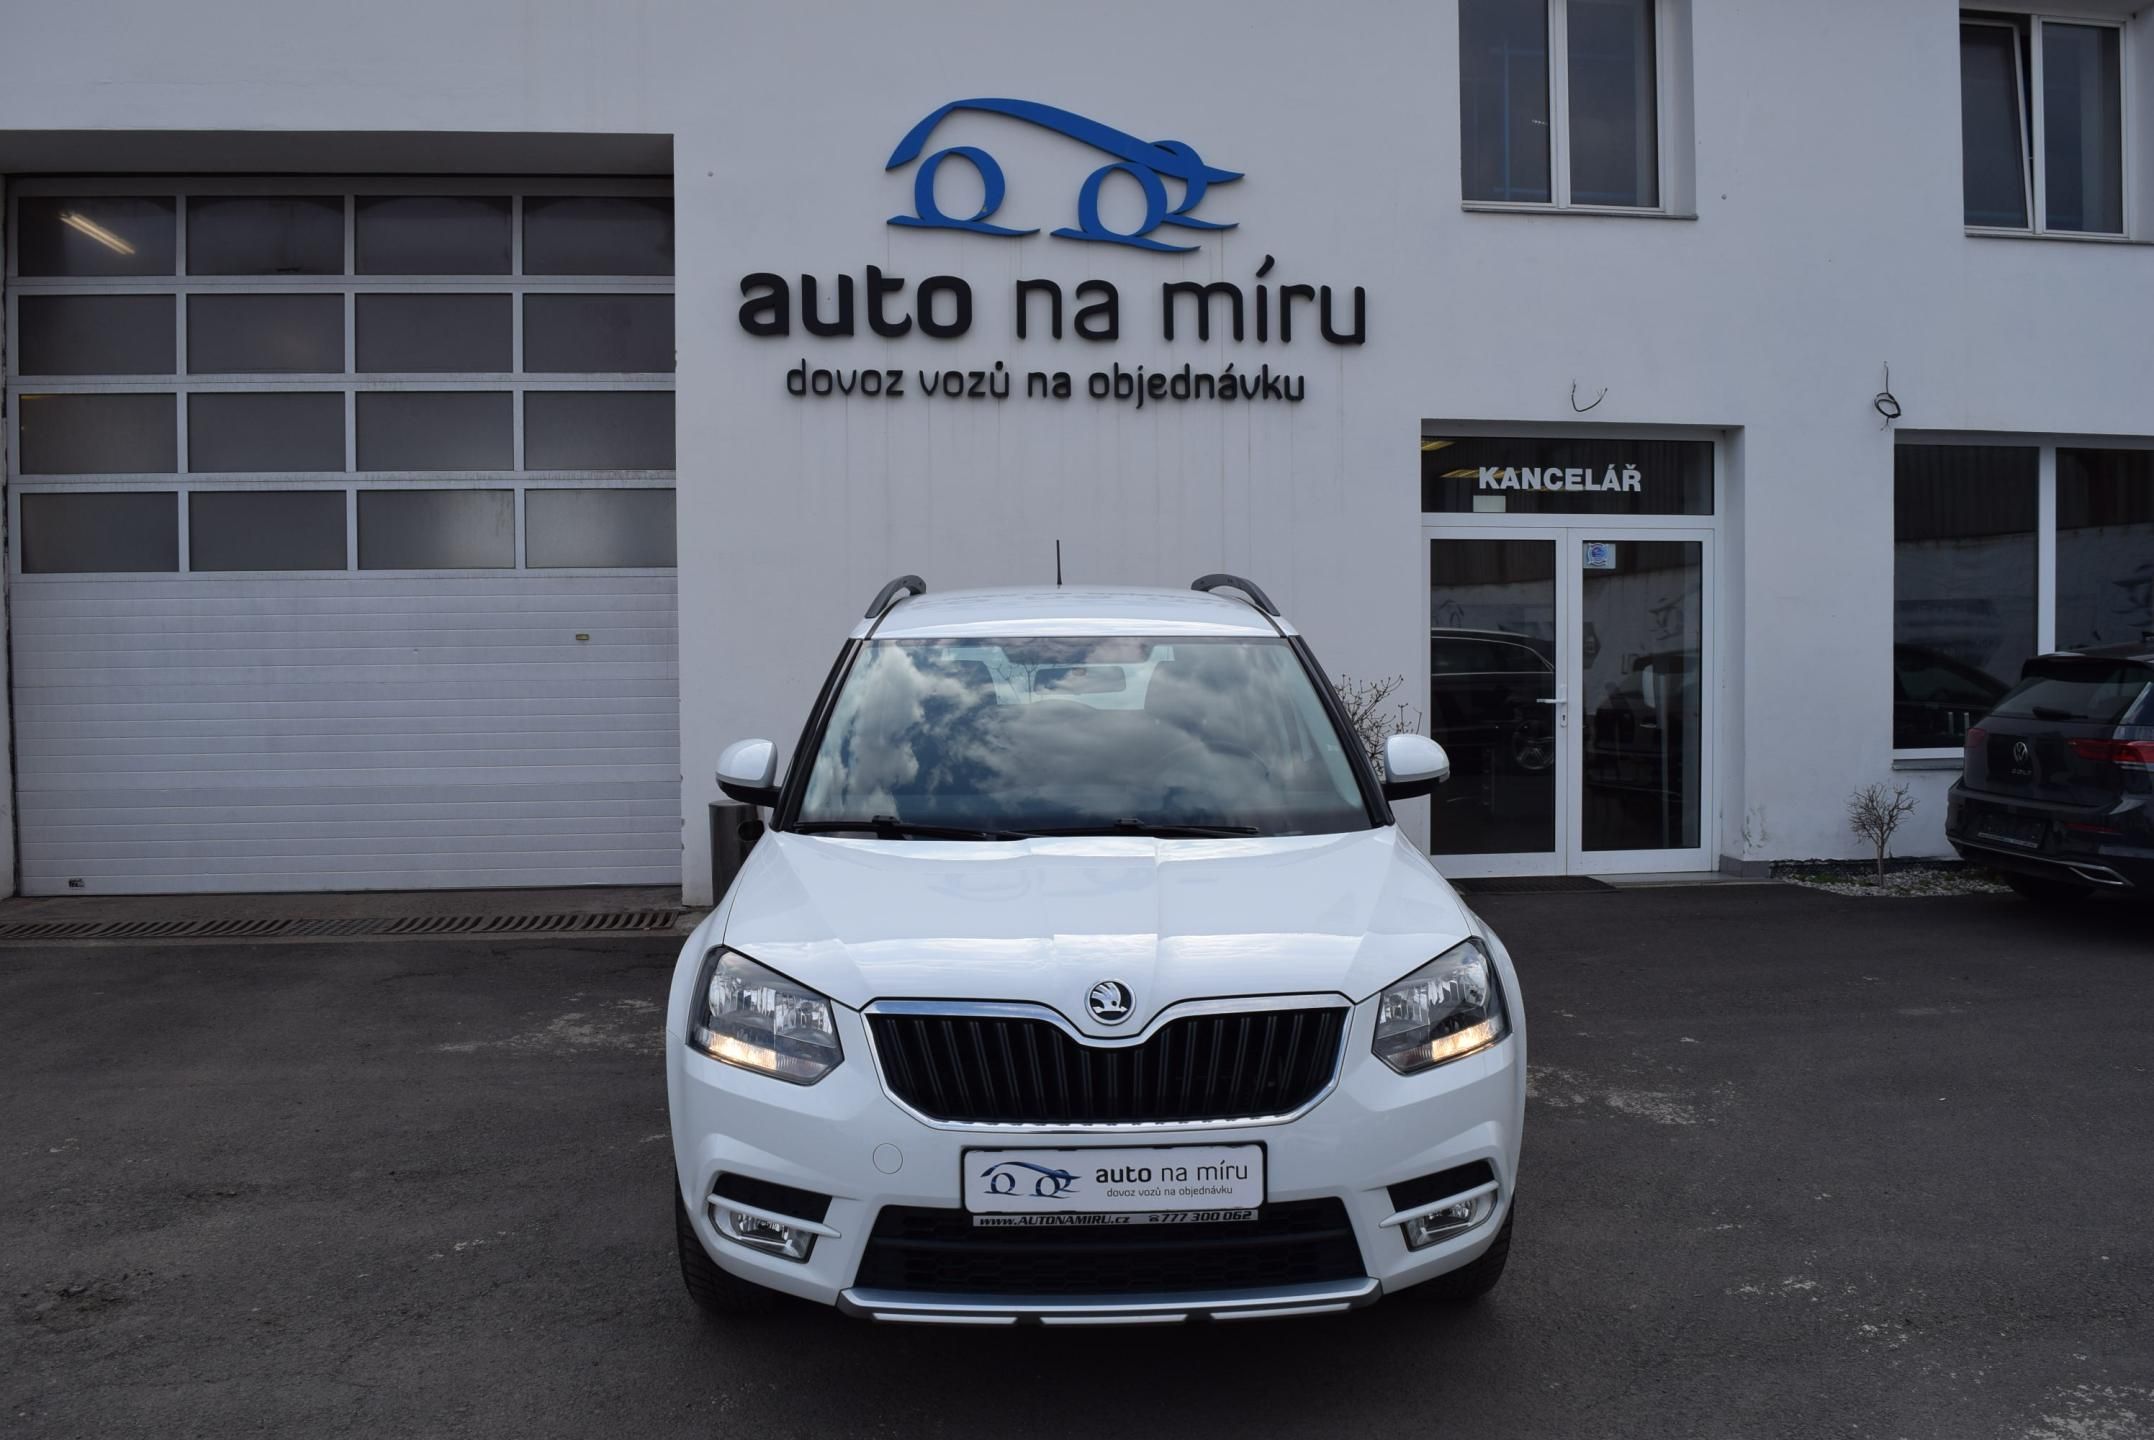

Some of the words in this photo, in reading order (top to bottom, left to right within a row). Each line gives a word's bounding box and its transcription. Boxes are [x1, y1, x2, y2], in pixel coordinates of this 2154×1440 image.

[738, 264, 973, 339] auto
[1015, 278, 1119, 341] na
[1162, 254, 1366, 345] míru
[786, 358, 904, 398] dovoz
[919, 360, 1011, 399] vozů
[1027, 370, 1072, 398] na
[1088, 363, 1304, 408] objednávku
[1478, 463, 1642, 492] KANCELÁŘ
[1095, 1166, 1151, 1184] auto
[1161, 1166, 1187, 1182] na
[1197, 1159, 1248, 1181] míru
[1106, 1187, 1136, 1198] dovoz
[1138, 1186, 1161, 1197] vozů
[1164, 1188, 1176, 1196] na
[1178, 1185, 1233, 1198] objednávku
[1161, 1213, 1188, 1223] 777
[1191, 1212, 1220, 1222] 300
[1223, 1210, 1252, 1221] 062
